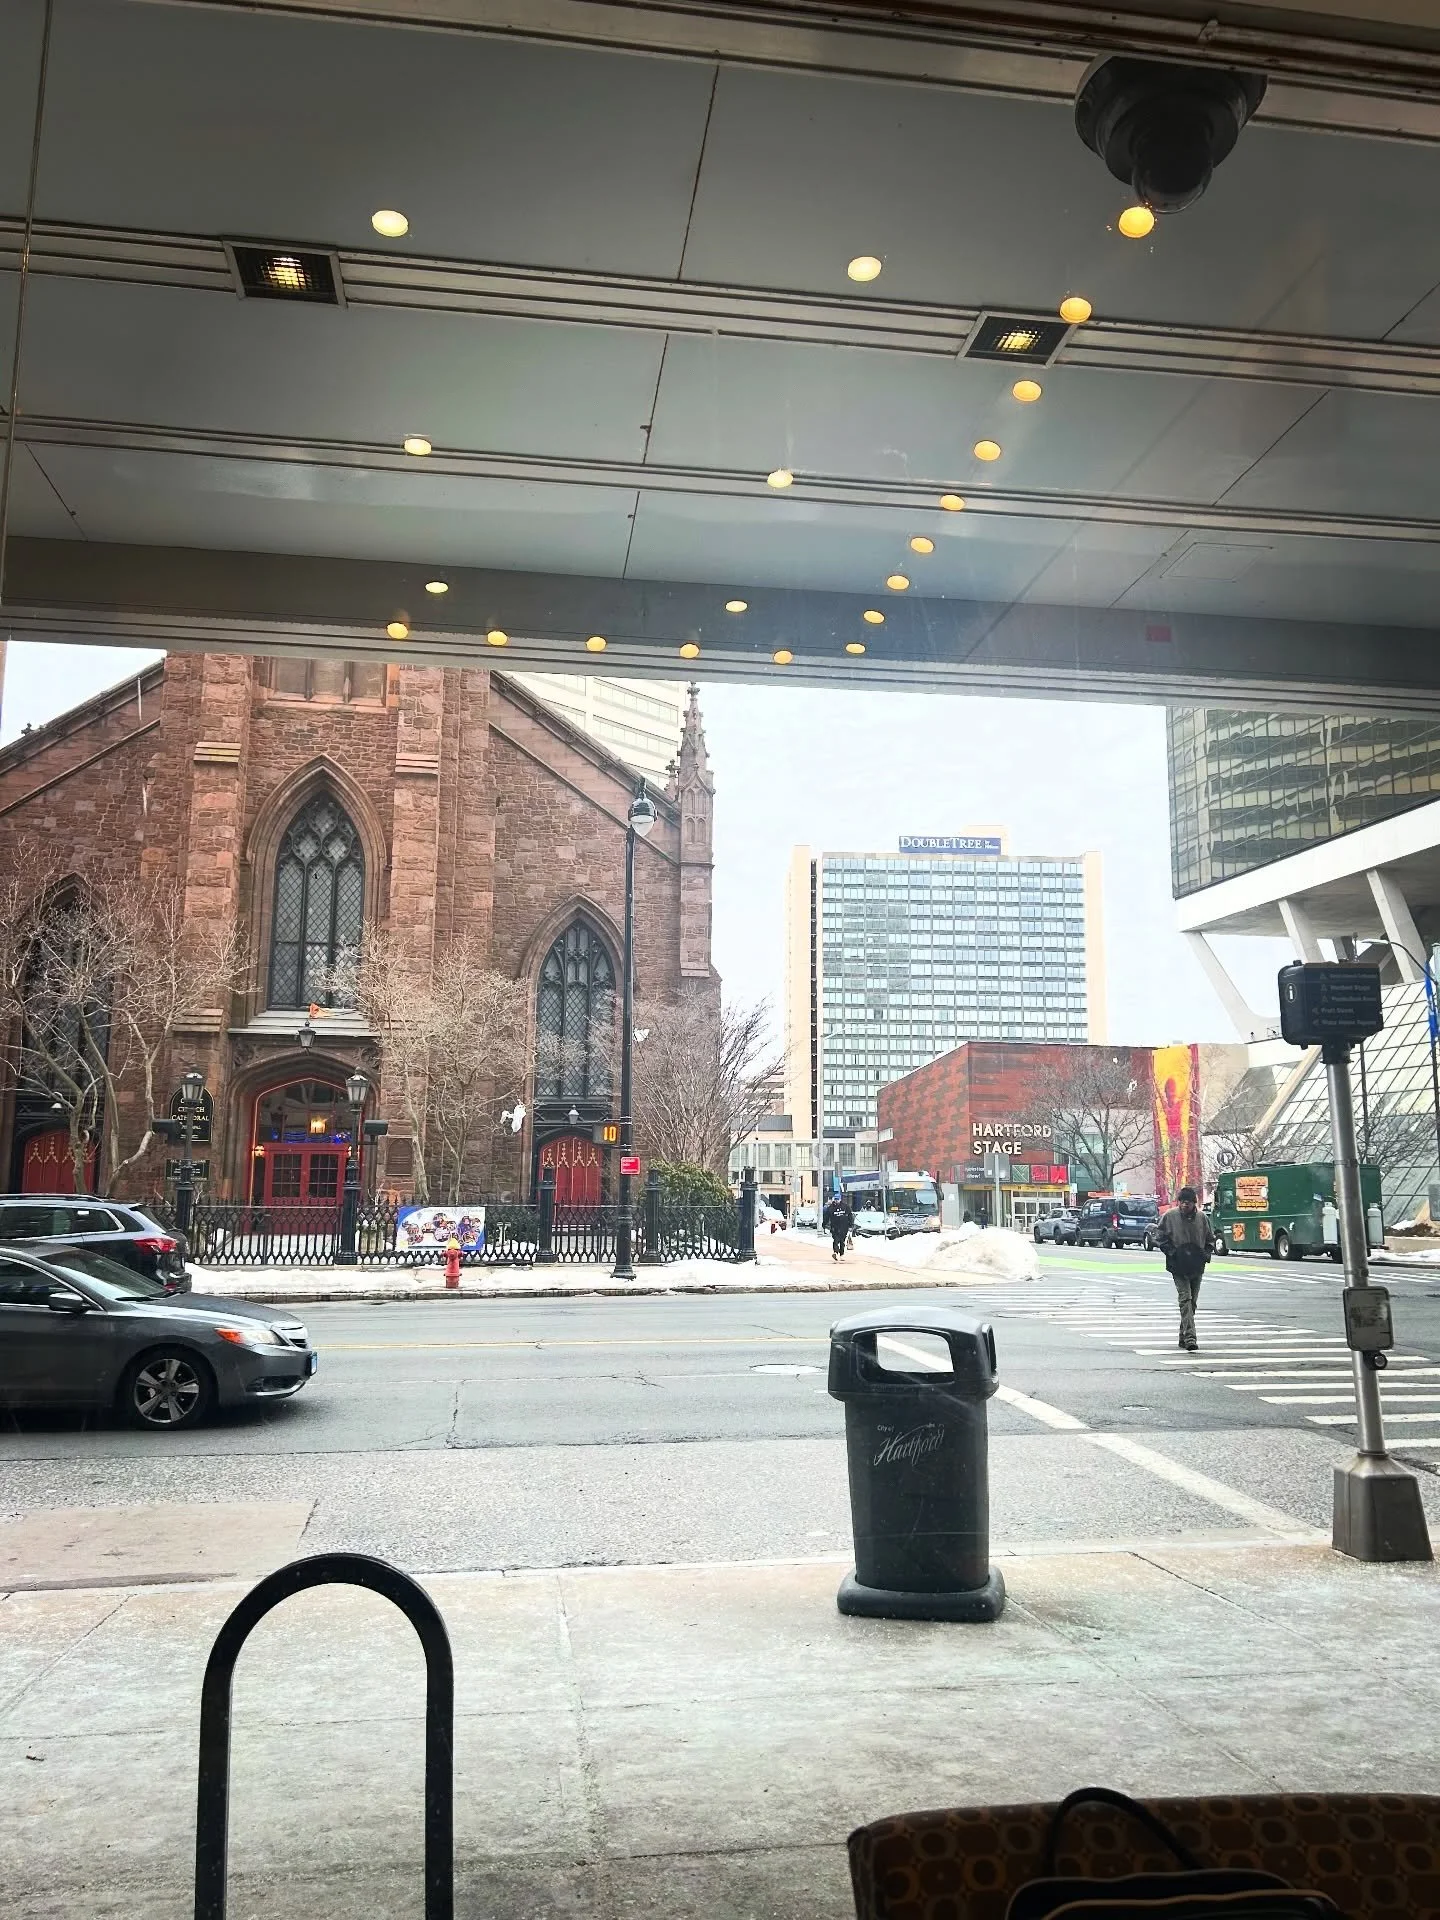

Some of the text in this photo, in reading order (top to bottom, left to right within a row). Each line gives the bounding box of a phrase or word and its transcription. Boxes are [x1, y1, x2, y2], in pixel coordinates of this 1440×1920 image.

[603, 1126, 617, 1142] 10
[972, 1122, 1052, 1138] HARTFORD
[973, 1140, 1022, 1155] STAGE
[873, 1424, 945, 1468] Hartford
